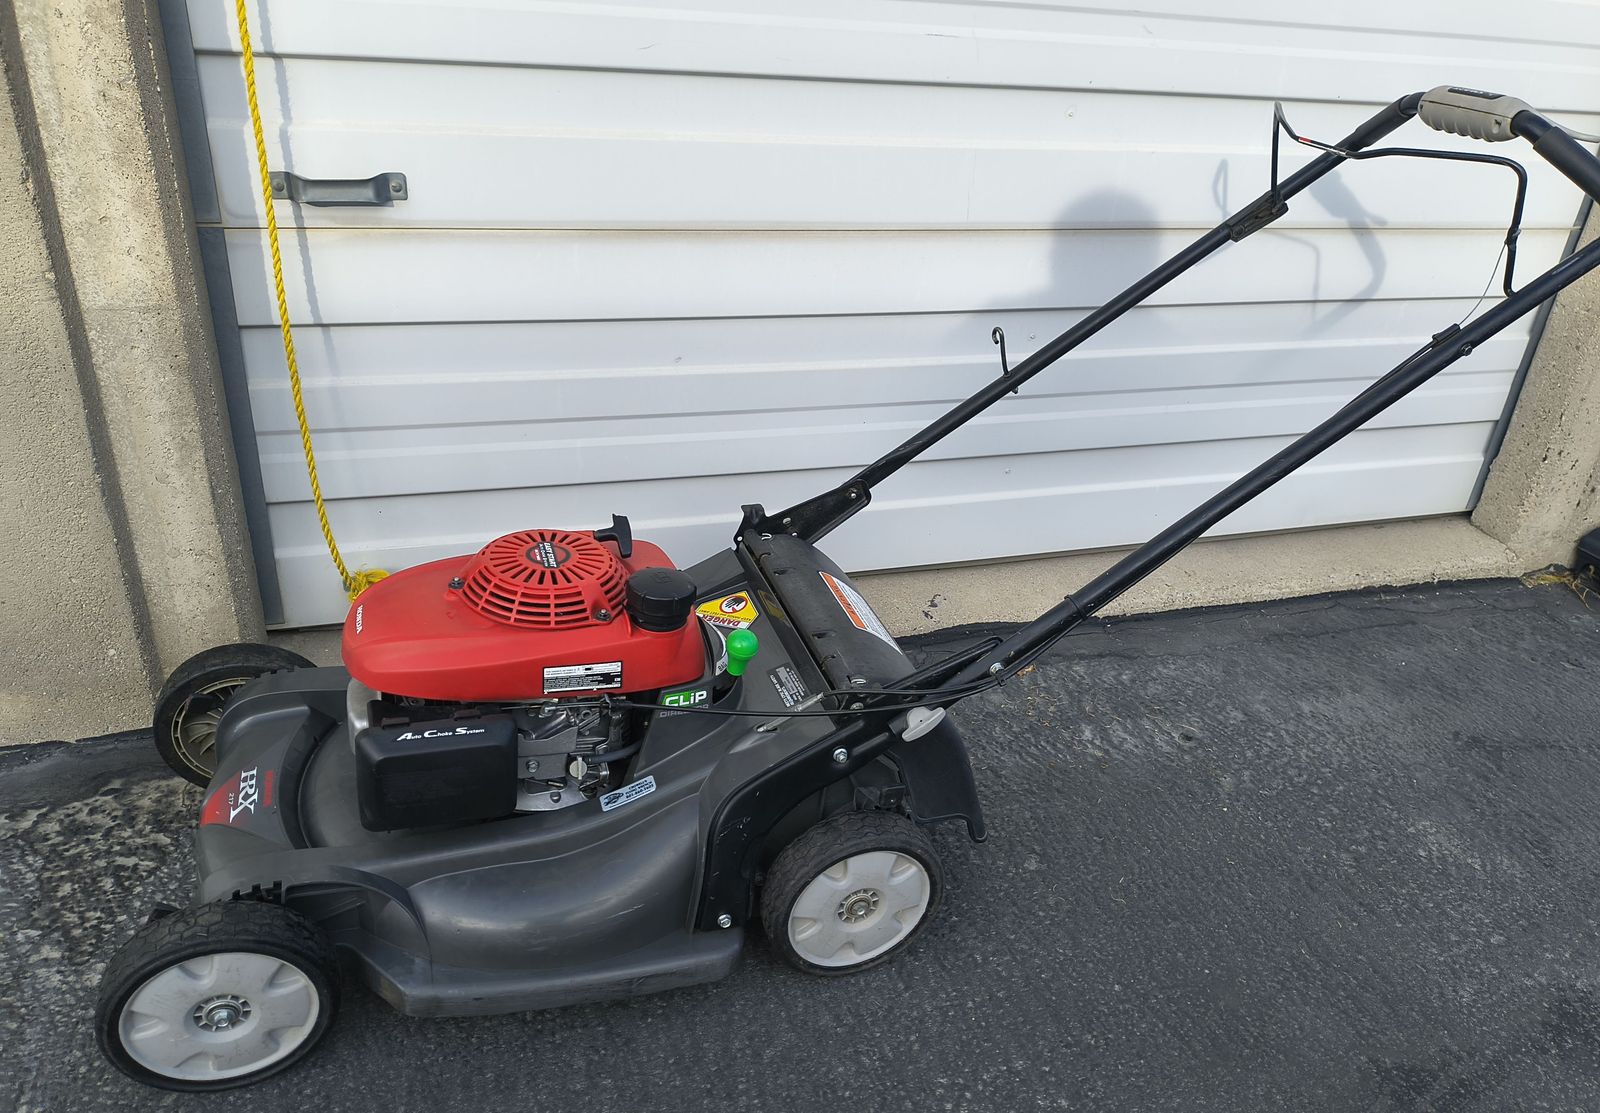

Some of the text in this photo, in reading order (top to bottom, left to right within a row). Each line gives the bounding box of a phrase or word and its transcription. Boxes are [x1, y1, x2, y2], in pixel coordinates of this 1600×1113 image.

[355, 604, 363, 635] HONDA
[702, 614, 740, 627] DANGER
[396, 727, 485, 741] Auto Choke System
[230, 766, 258, 823] HRX
